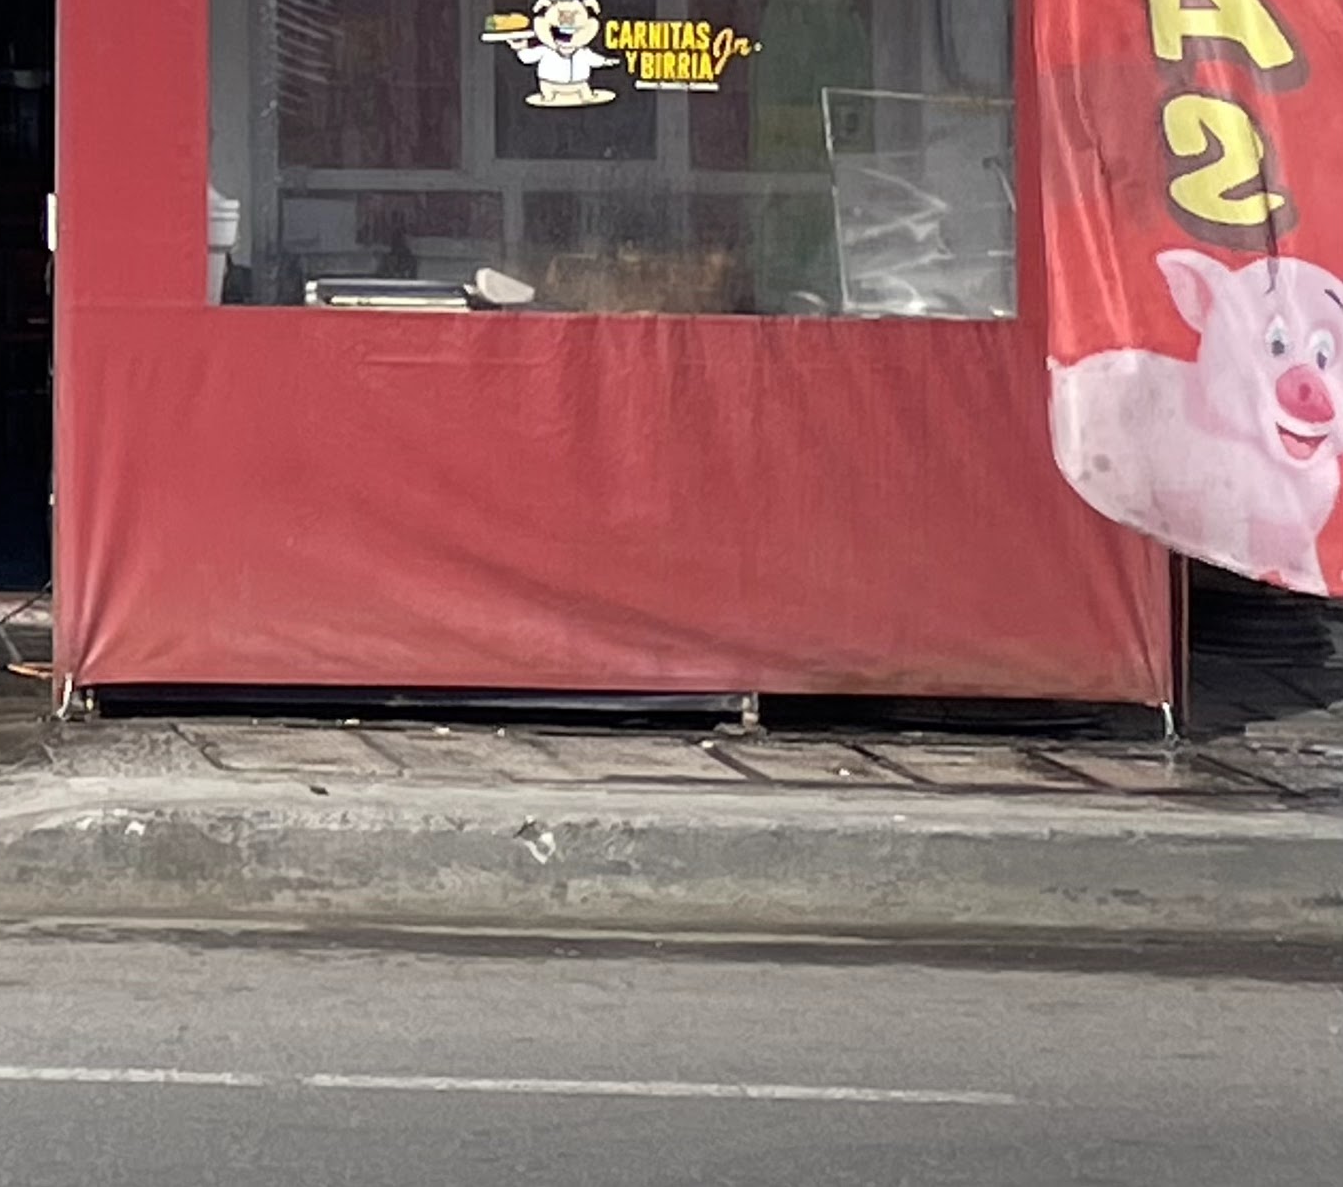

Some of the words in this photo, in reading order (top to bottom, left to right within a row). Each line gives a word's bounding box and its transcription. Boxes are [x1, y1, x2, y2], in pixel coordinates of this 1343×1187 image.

[604, 20, 712, 51] CARNITAS
[625, 50, 638, 74] Y
[640, 51, 714, 81] BIRRIA
